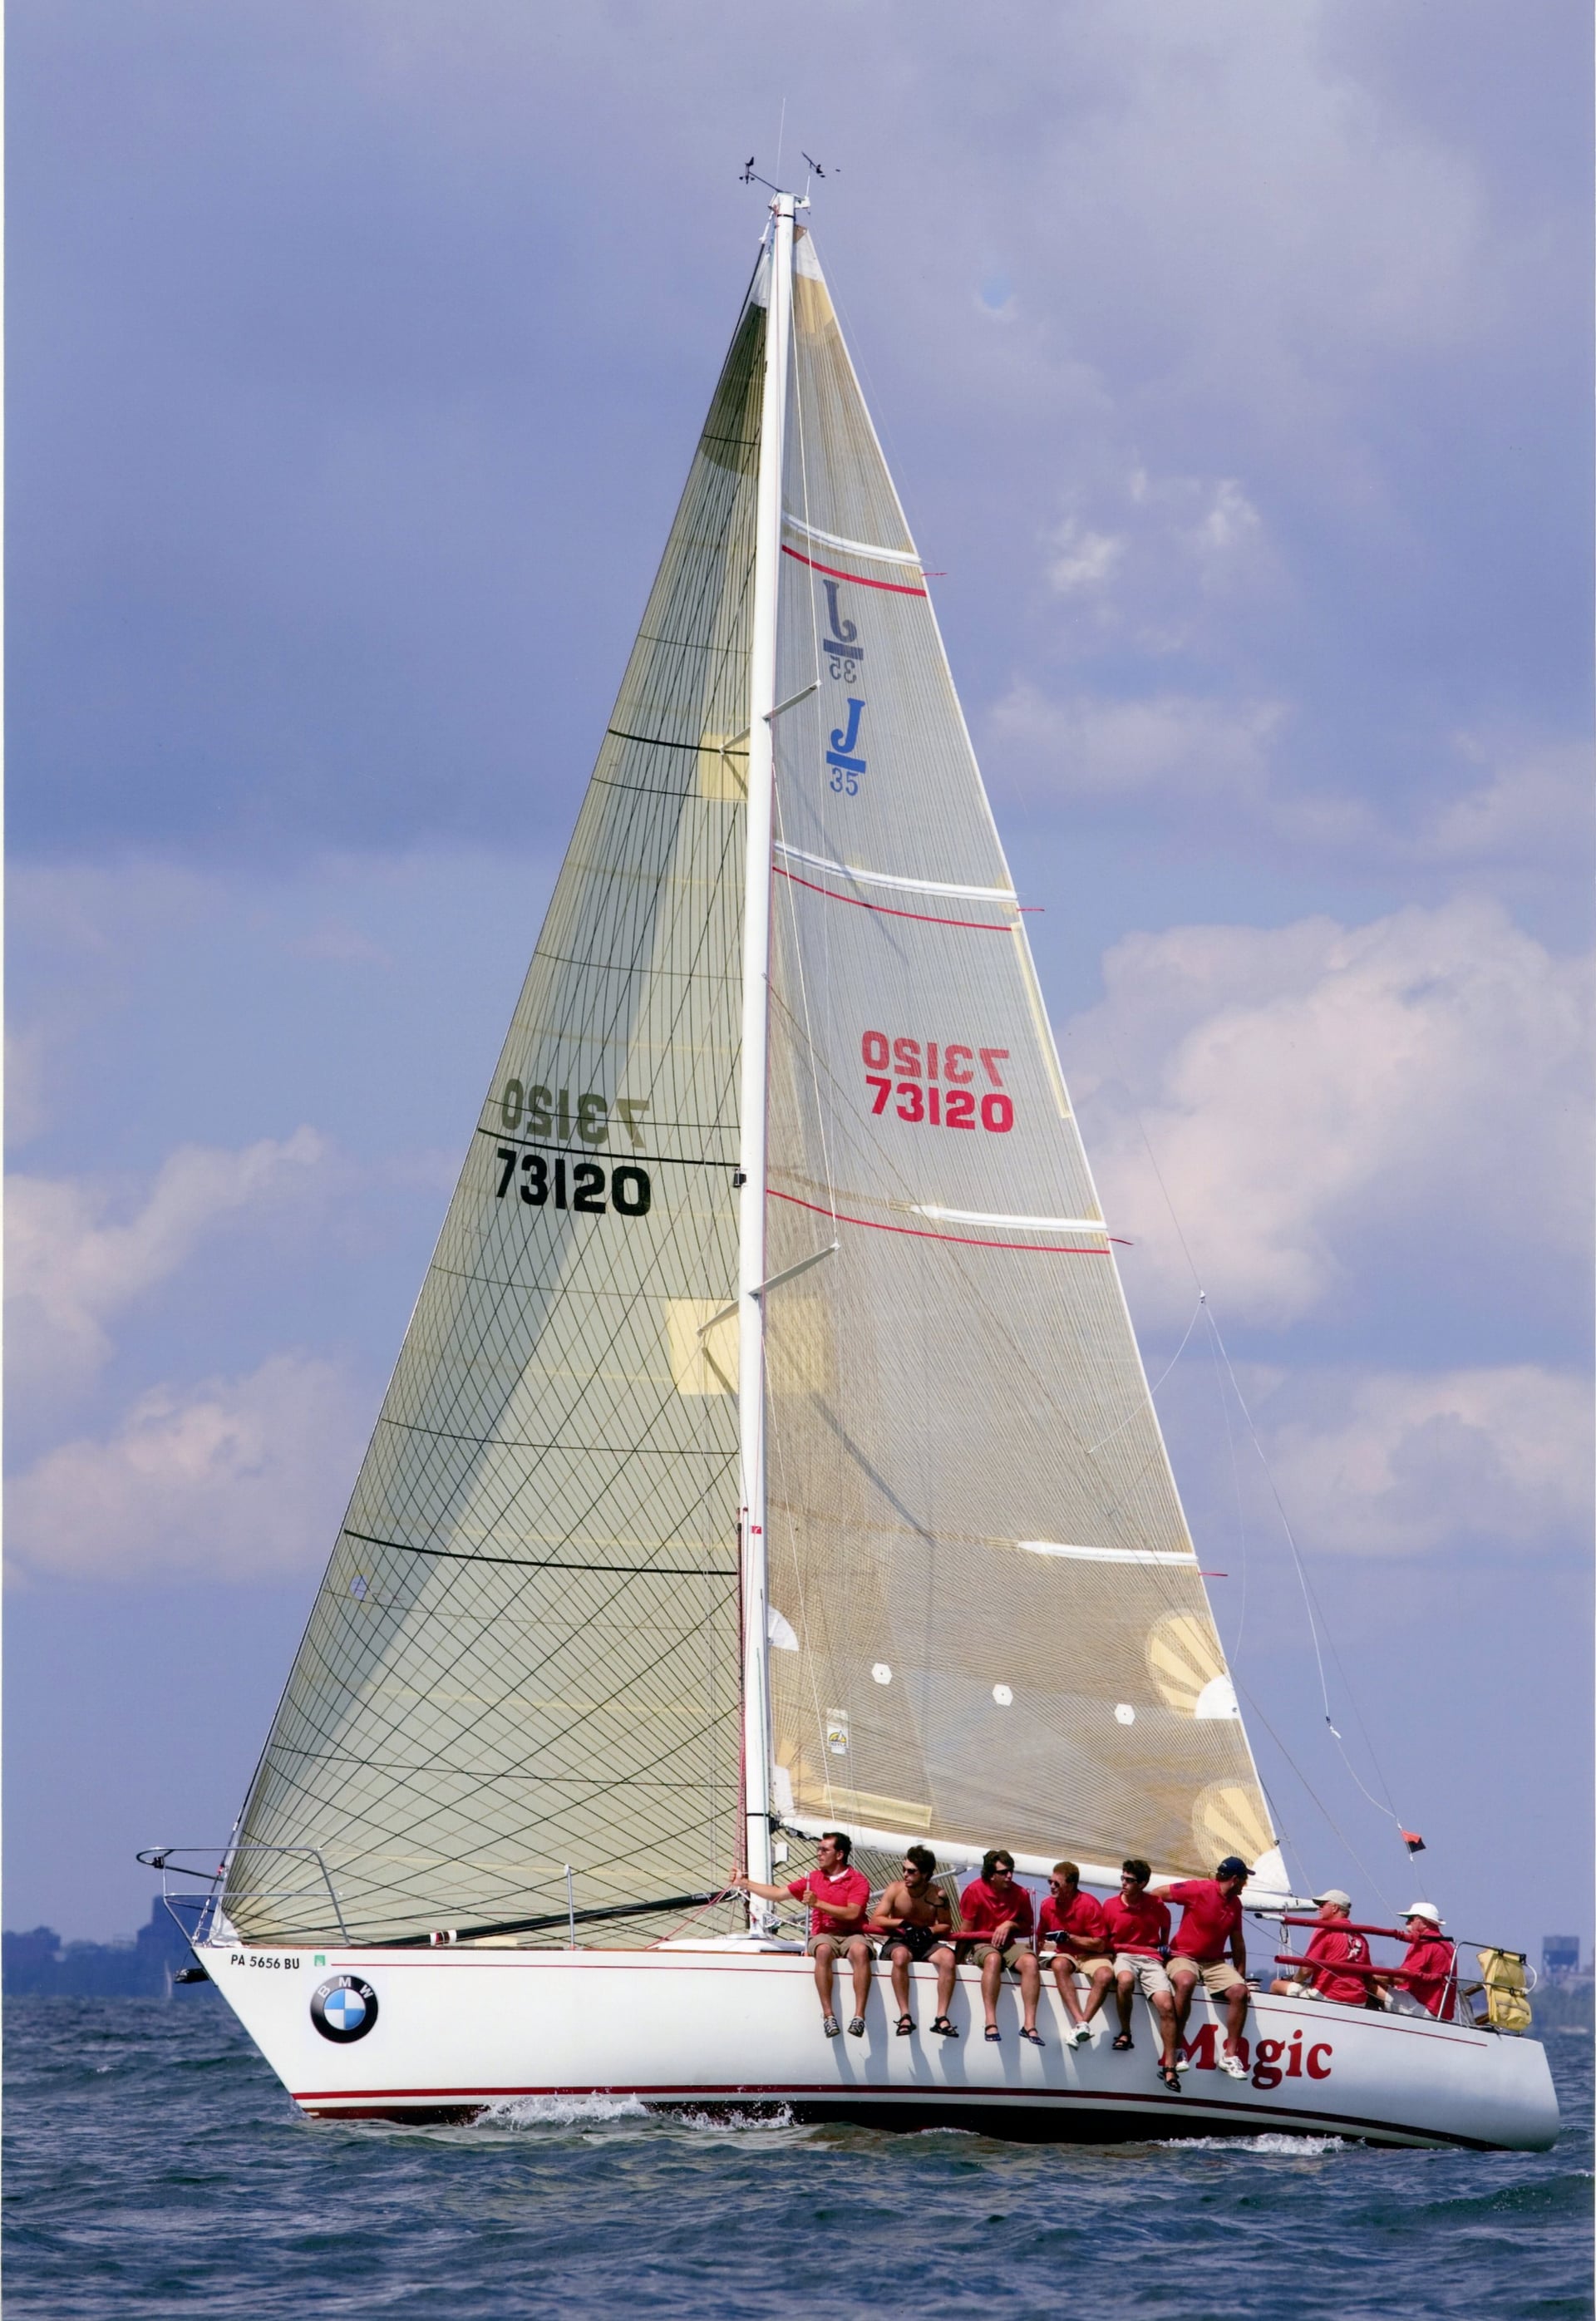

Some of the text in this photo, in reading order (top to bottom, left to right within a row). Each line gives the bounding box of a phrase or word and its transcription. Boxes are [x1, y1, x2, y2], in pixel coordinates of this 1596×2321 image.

[830, 697, 865, 753] J
[830, 767, 859, 796] 35
[865, 1075, 1014, 1133] 73120
[496, 1147, 651, 1217] 73120
[230, 1954, 300, 1969] PA 5656 BU
[318, 1976, 373, 1999] BMW
